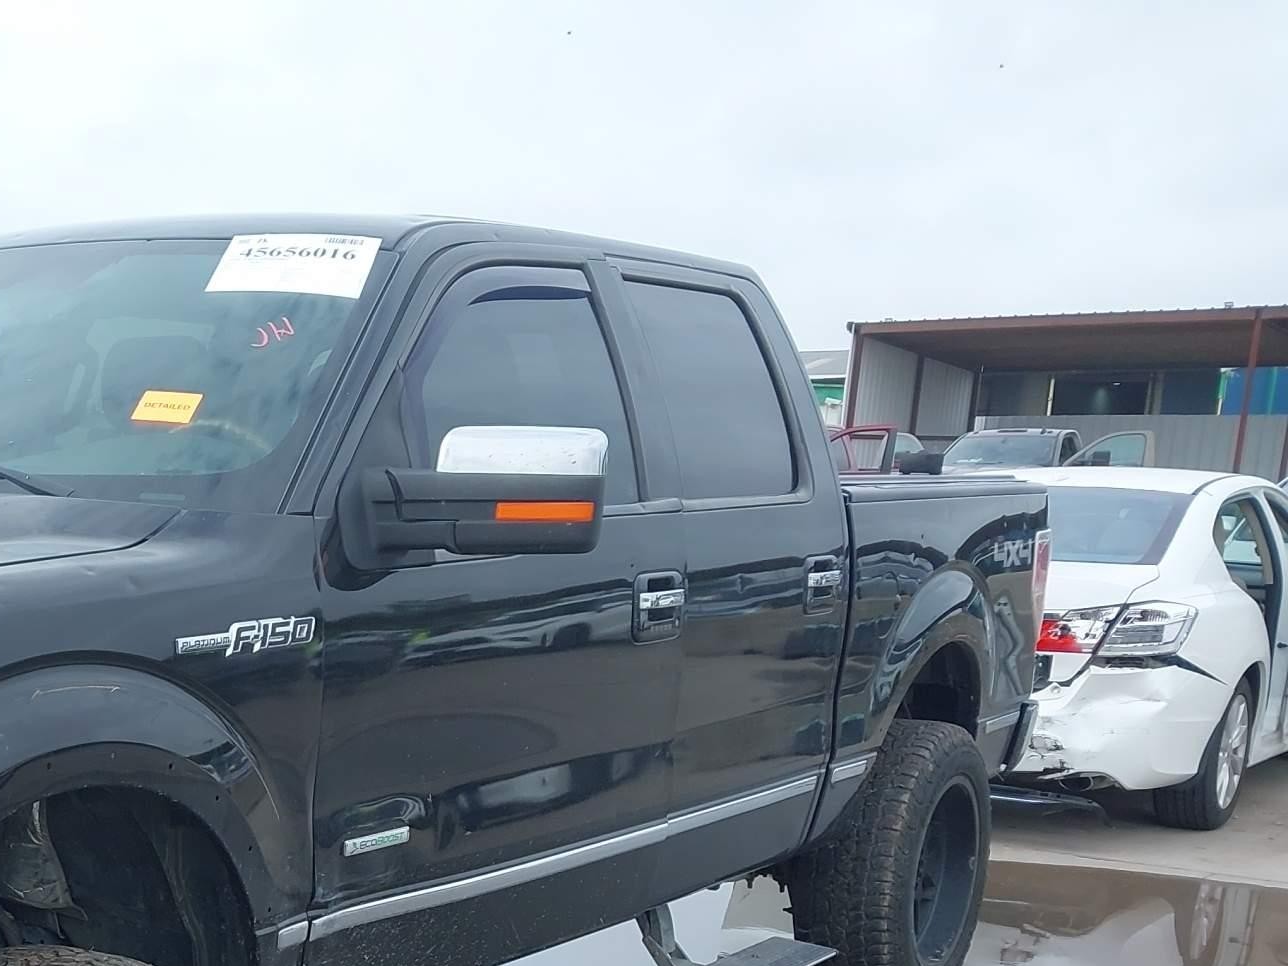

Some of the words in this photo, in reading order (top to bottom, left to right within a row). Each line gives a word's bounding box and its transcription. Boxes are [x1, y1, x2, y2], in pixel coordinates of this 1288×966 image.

[239, 246, 357, 261] 45656016
[143, 401, 191, 411] DETAILED
[180, 635, 231, 650] PLATINUM
